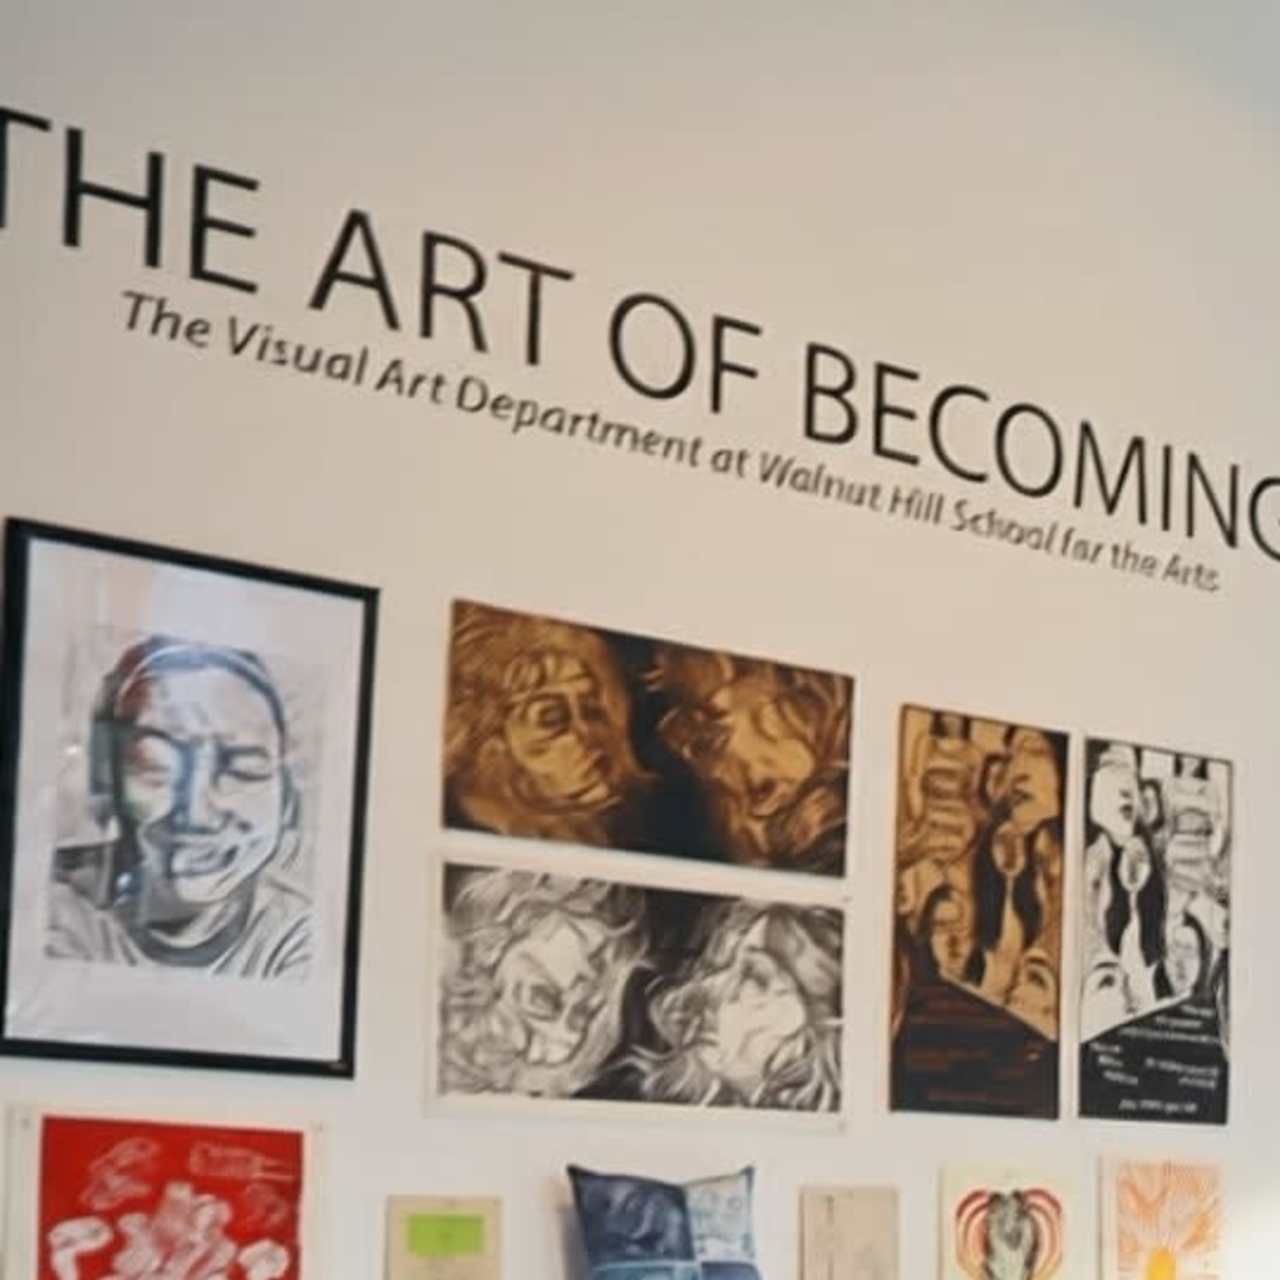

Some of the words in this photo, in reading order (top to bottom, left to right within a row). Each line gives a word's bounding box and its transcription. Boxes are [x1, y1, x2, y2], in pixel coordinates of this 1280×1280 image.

[306, 207, 576, 368] ART
[607, 291, 764, 416] OF
[122, 289, 212, 349] The
[227, 315, 370, 387] Visual
[373, 357, 448, 406] Art
[455, 374, 704, 468] Department
[708, 448, 751, 479] at
[758, 450, 883, 512] Walnut
[887, 485, 946, 526] Hill
[950, 498, 1060, 555] School
[1058, 526, 1106, 565] for
[1109, 540, 1159, 579] the
[1161, 553, 1221, 594] Arts
